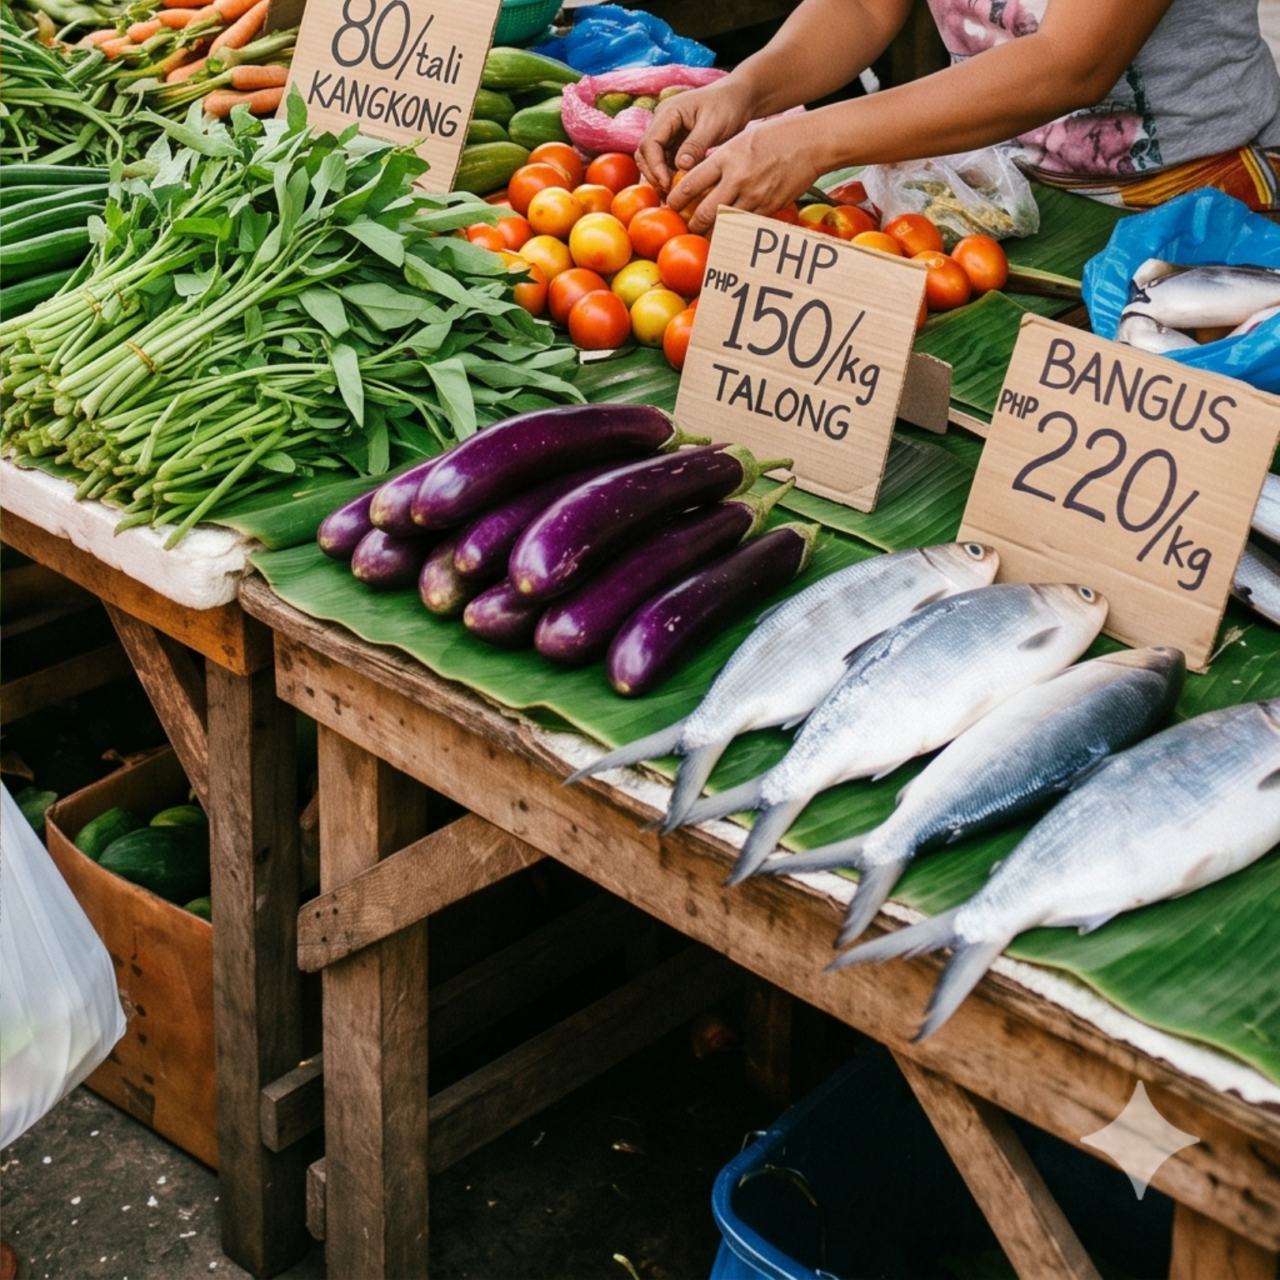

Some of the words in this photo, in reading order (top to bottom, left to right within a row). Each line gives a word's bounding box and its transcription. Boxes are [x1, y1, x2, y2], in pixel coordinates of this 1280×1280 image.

[307, 70, 462, 138] KANGKONG
[750, 227, 839, 285] PHP
[704, 268, 739, 293] PHP
[722, 282, 880, 406] 150/kg
[713, 363, 851, 441] TALONG
[998, 388, 1040, 420] PHP
[1038, 337, 1238, 444] BANGUS
[1011, 410, 1213, 591] 220/kg
